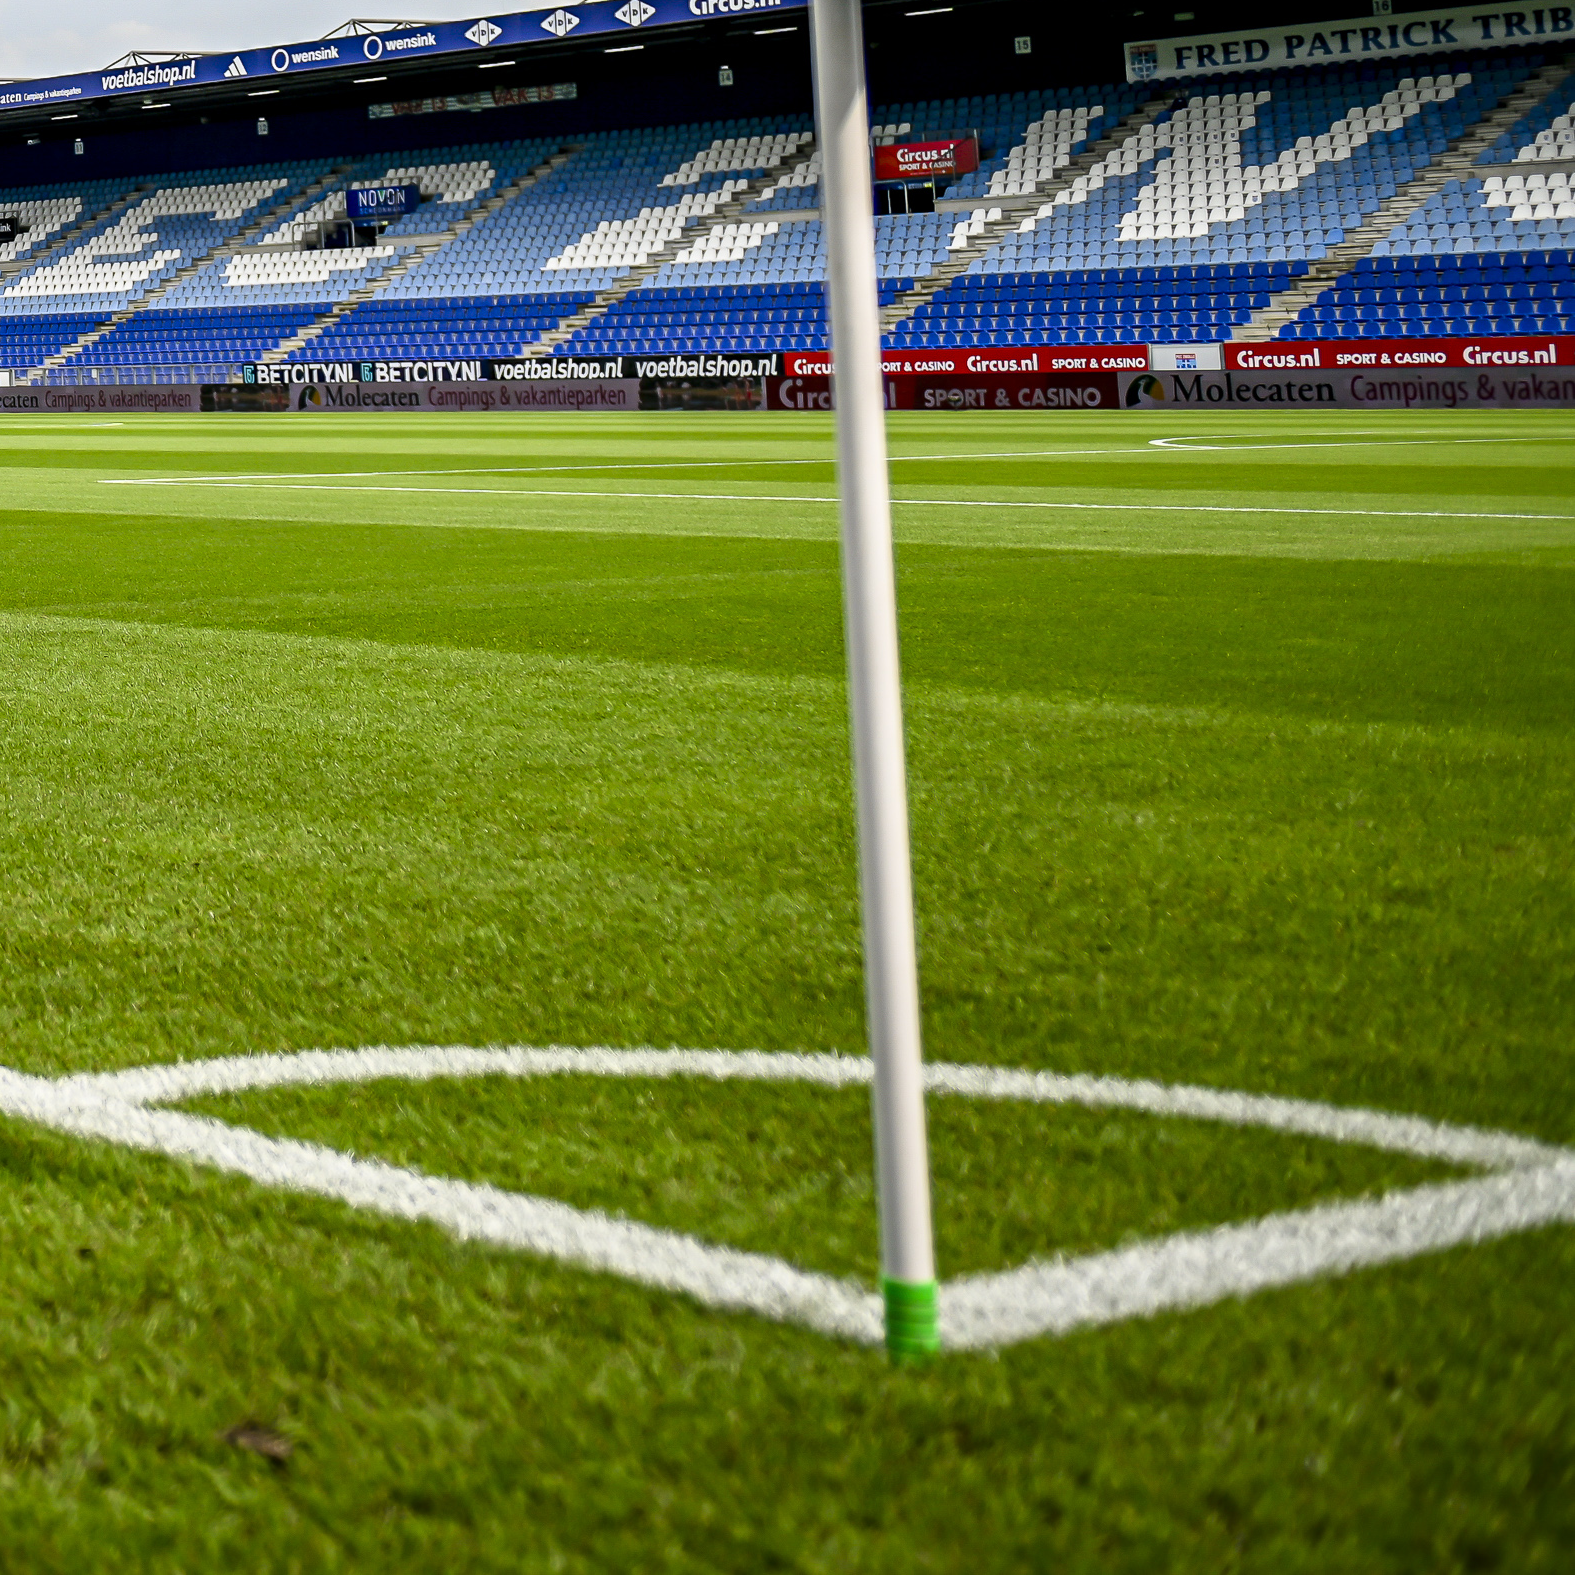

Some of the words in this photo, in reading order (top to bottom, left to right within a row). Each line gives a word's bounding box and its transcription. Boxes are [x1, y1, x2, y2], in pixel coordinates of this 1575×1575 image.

[1374, 0, 1390, 12] 16
[385, 32, 437, 52] wensink
[1017, 40, 1029, 51] 15
[1173, 37, 1270, 70] FRED
[1284, 17, 1459, 59] PATRICK
[291, 45, 340, 64] wensink
[101, 60, 196, 91] voetbalshop.nl
[899, 162, 922, 171] SPORT
[358, 188, 406, 207] NOVON
[966, 353, 1039, 373] Circus.nl
[1051, 357, 1087, 370] SPORT
[1089, 357, 1099, 369] &
[1101, 356, 1146, 369] CASINO
[1236, 347, 1321, 368] Circus.nl
[1336, 353, 1376, 366] SPORT
[1380, 352, 1392, 365] &
[1394, 351, 1447, 365] CASINO
[1462, 343, 1557, 366] Circus.nl
[256, 363, 359, 384] BETCITY.NL
[375, 360, 488, 383] BETCITY.NL
[494, 356, 624, 380] voetbalshop.nl
[636, 354, 778, 379] voetbalshop.nl
[903, 361, 913, 372] &
[914, 359, 955, 373] CASINO
[45, 390, 95, 412] Campings
[97, 390, 106, 407] &
[109, 389, 191, 411] vakantieparken
[324, 385, 420, 407] Molecaten
[428, 386, 496, 411] Campings
[500, 385, 511, 406] &
[515, 384, 626, 411] vakantieparken
[924, 388, 988, 408] SPORT
[994, 388, 1011, 407] &
[1017, 386, 1102, 407] CASINO
[1172, 373, 1337, 403] Molecaten
[1351, 375, 1469, 408] Campings
[1476, 375, 1497, 400] &
